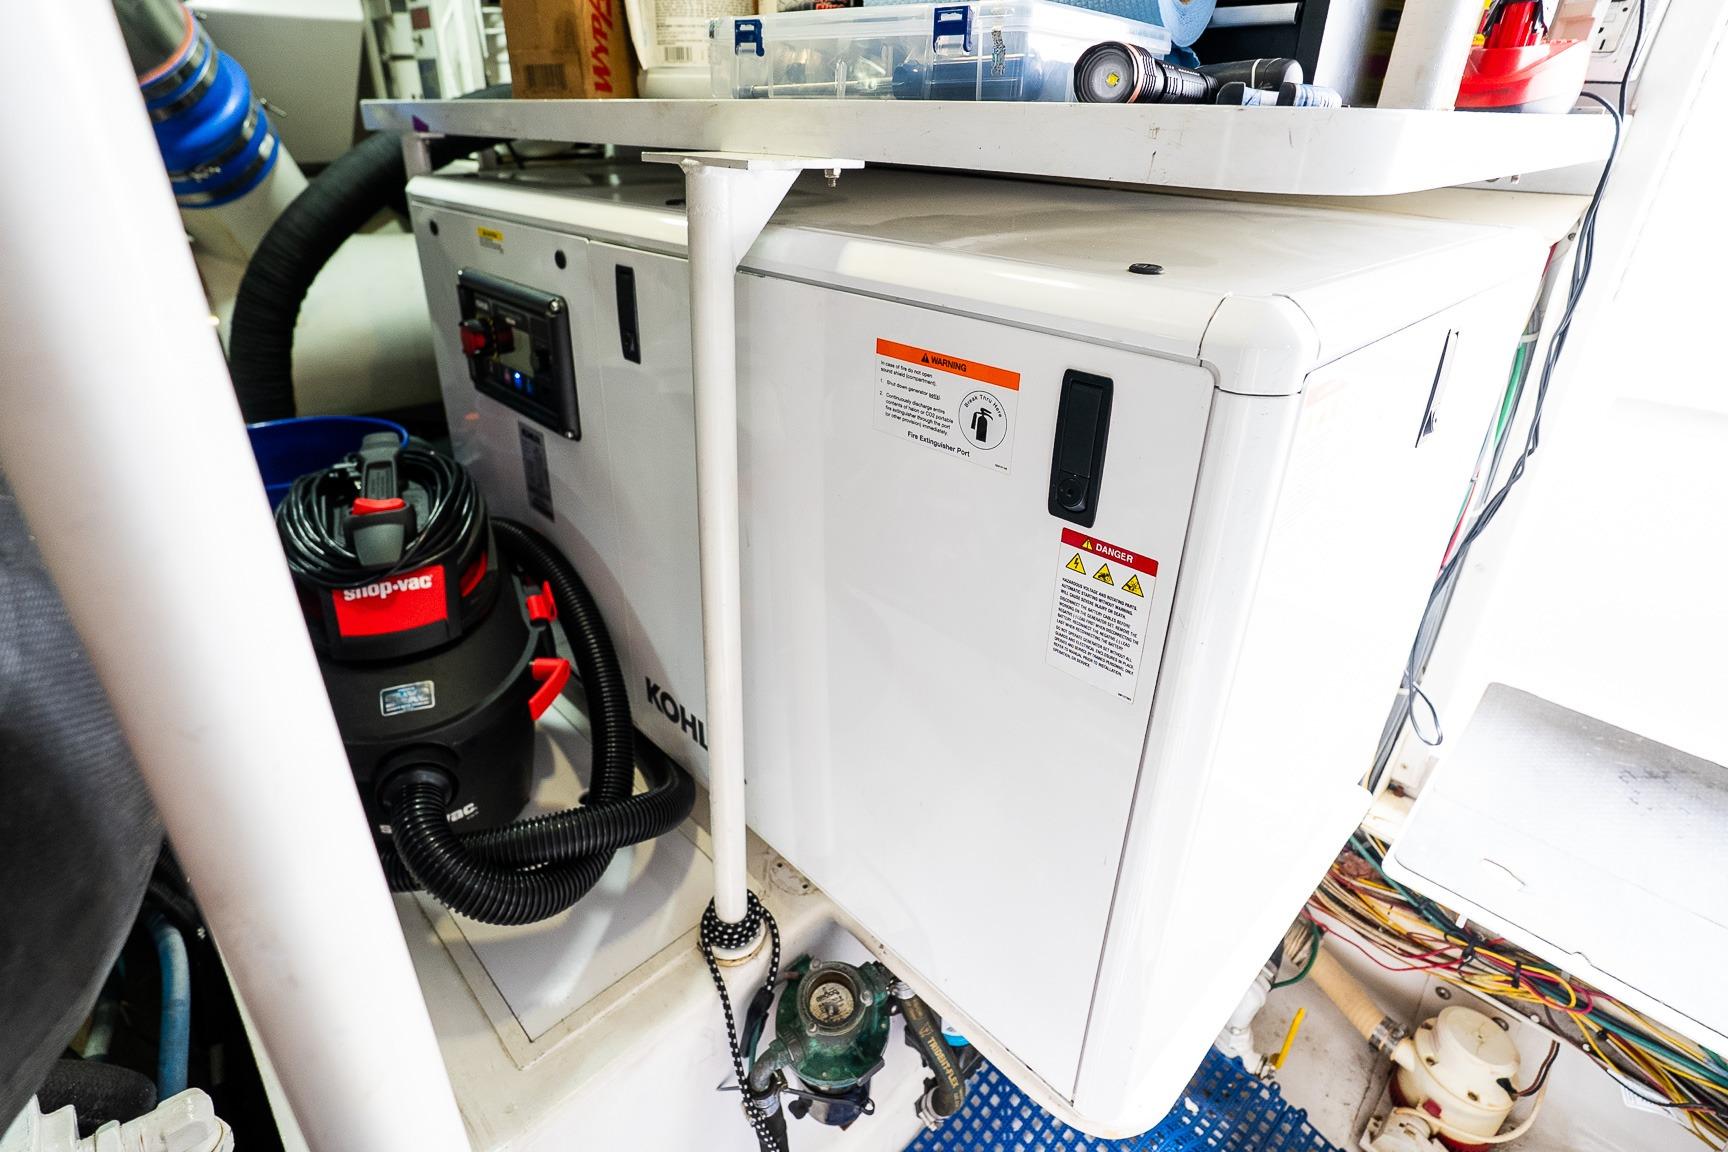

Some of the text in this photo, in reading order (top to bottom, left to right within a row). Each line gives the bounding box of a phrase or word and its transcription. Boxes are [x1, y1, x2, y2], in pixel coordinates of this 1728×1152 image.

[880, 366, 892, 374] sound
[893, 370, 905, 378] shield
[930, 355, 967, 372] WARNING
[921, 371, 932, 379] open
[896, 382, 907, 390] down
[908, 386, 928, 396] generator
[885, 392, 911, 404] Continuously
[911, 400, 932, 411] discharge
[932, 406, 945, 414] entire
[885, 399, 902, 408] contents
[935, 414, 953, 424] portable
[963, 391, 1003, 418] Break Thru Here
[891, 413, 901, 421] other
[892, 407, 916, 419] extinguisher
[916, 414, 933, 424] through
[940, 422, 950, 430] port
[907, 430, 970, 457] Fire Extinguisher Port
[1095, 542, 1133, 563] DANGER
[644, 676, 709, 752] KOHL
